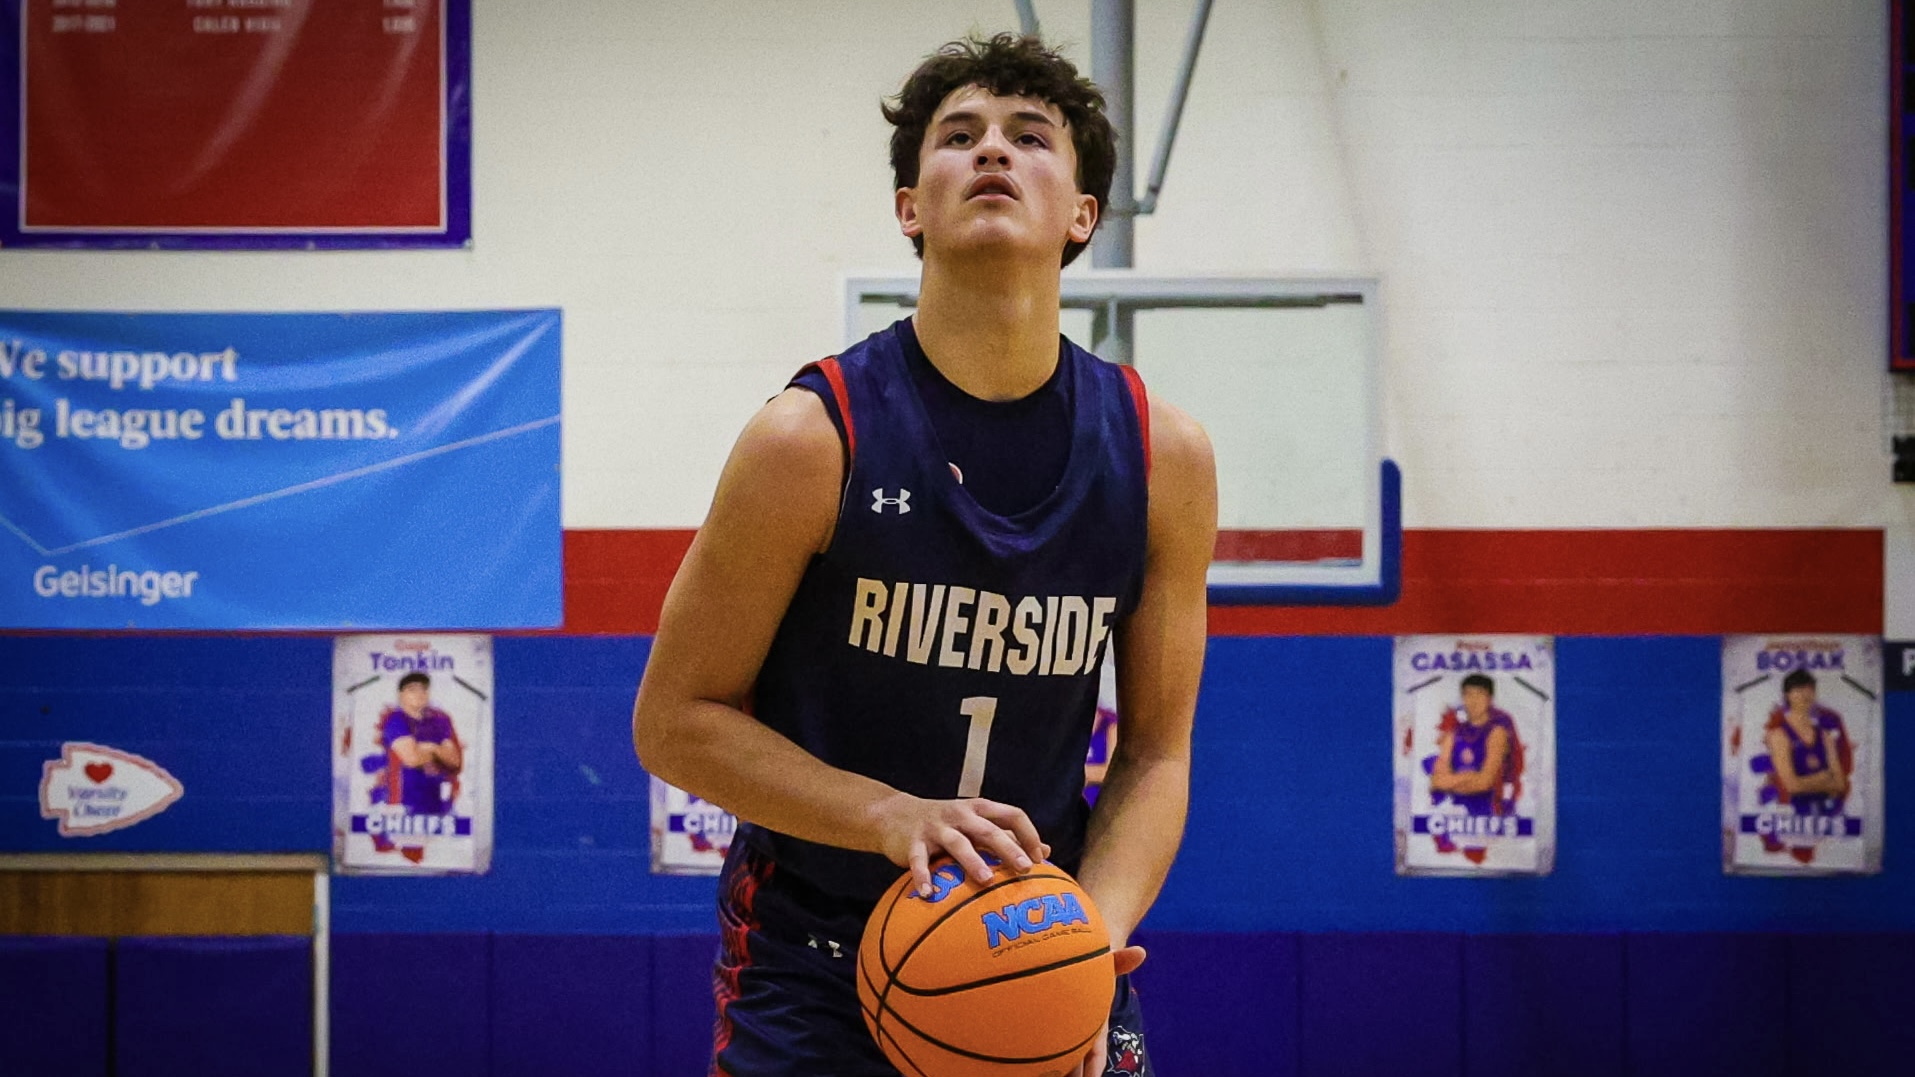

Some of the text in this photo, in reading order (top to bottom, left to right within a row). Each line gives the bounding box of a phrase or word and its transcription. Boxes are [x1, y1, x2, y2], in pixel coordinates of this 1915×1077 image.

[57, 346, 238, 388] support
[55, 398, 204, 449] league
[215, 398, 399, 440] dreams.
[33, 564, 199, 606] Geisinger
[848, 577, 1117, 676] RIVERSIDE
[1411, 651, 1533, 671] CASASSA
[957, 696, 998, 798] 1
[365, 813, 457, 836] CHIEFS
[1426, 814, 1519, 837] CHIEFS
[1755, 813, 1847, 836] CHIEFS
[981, 892, 1089, 950] NCAA
